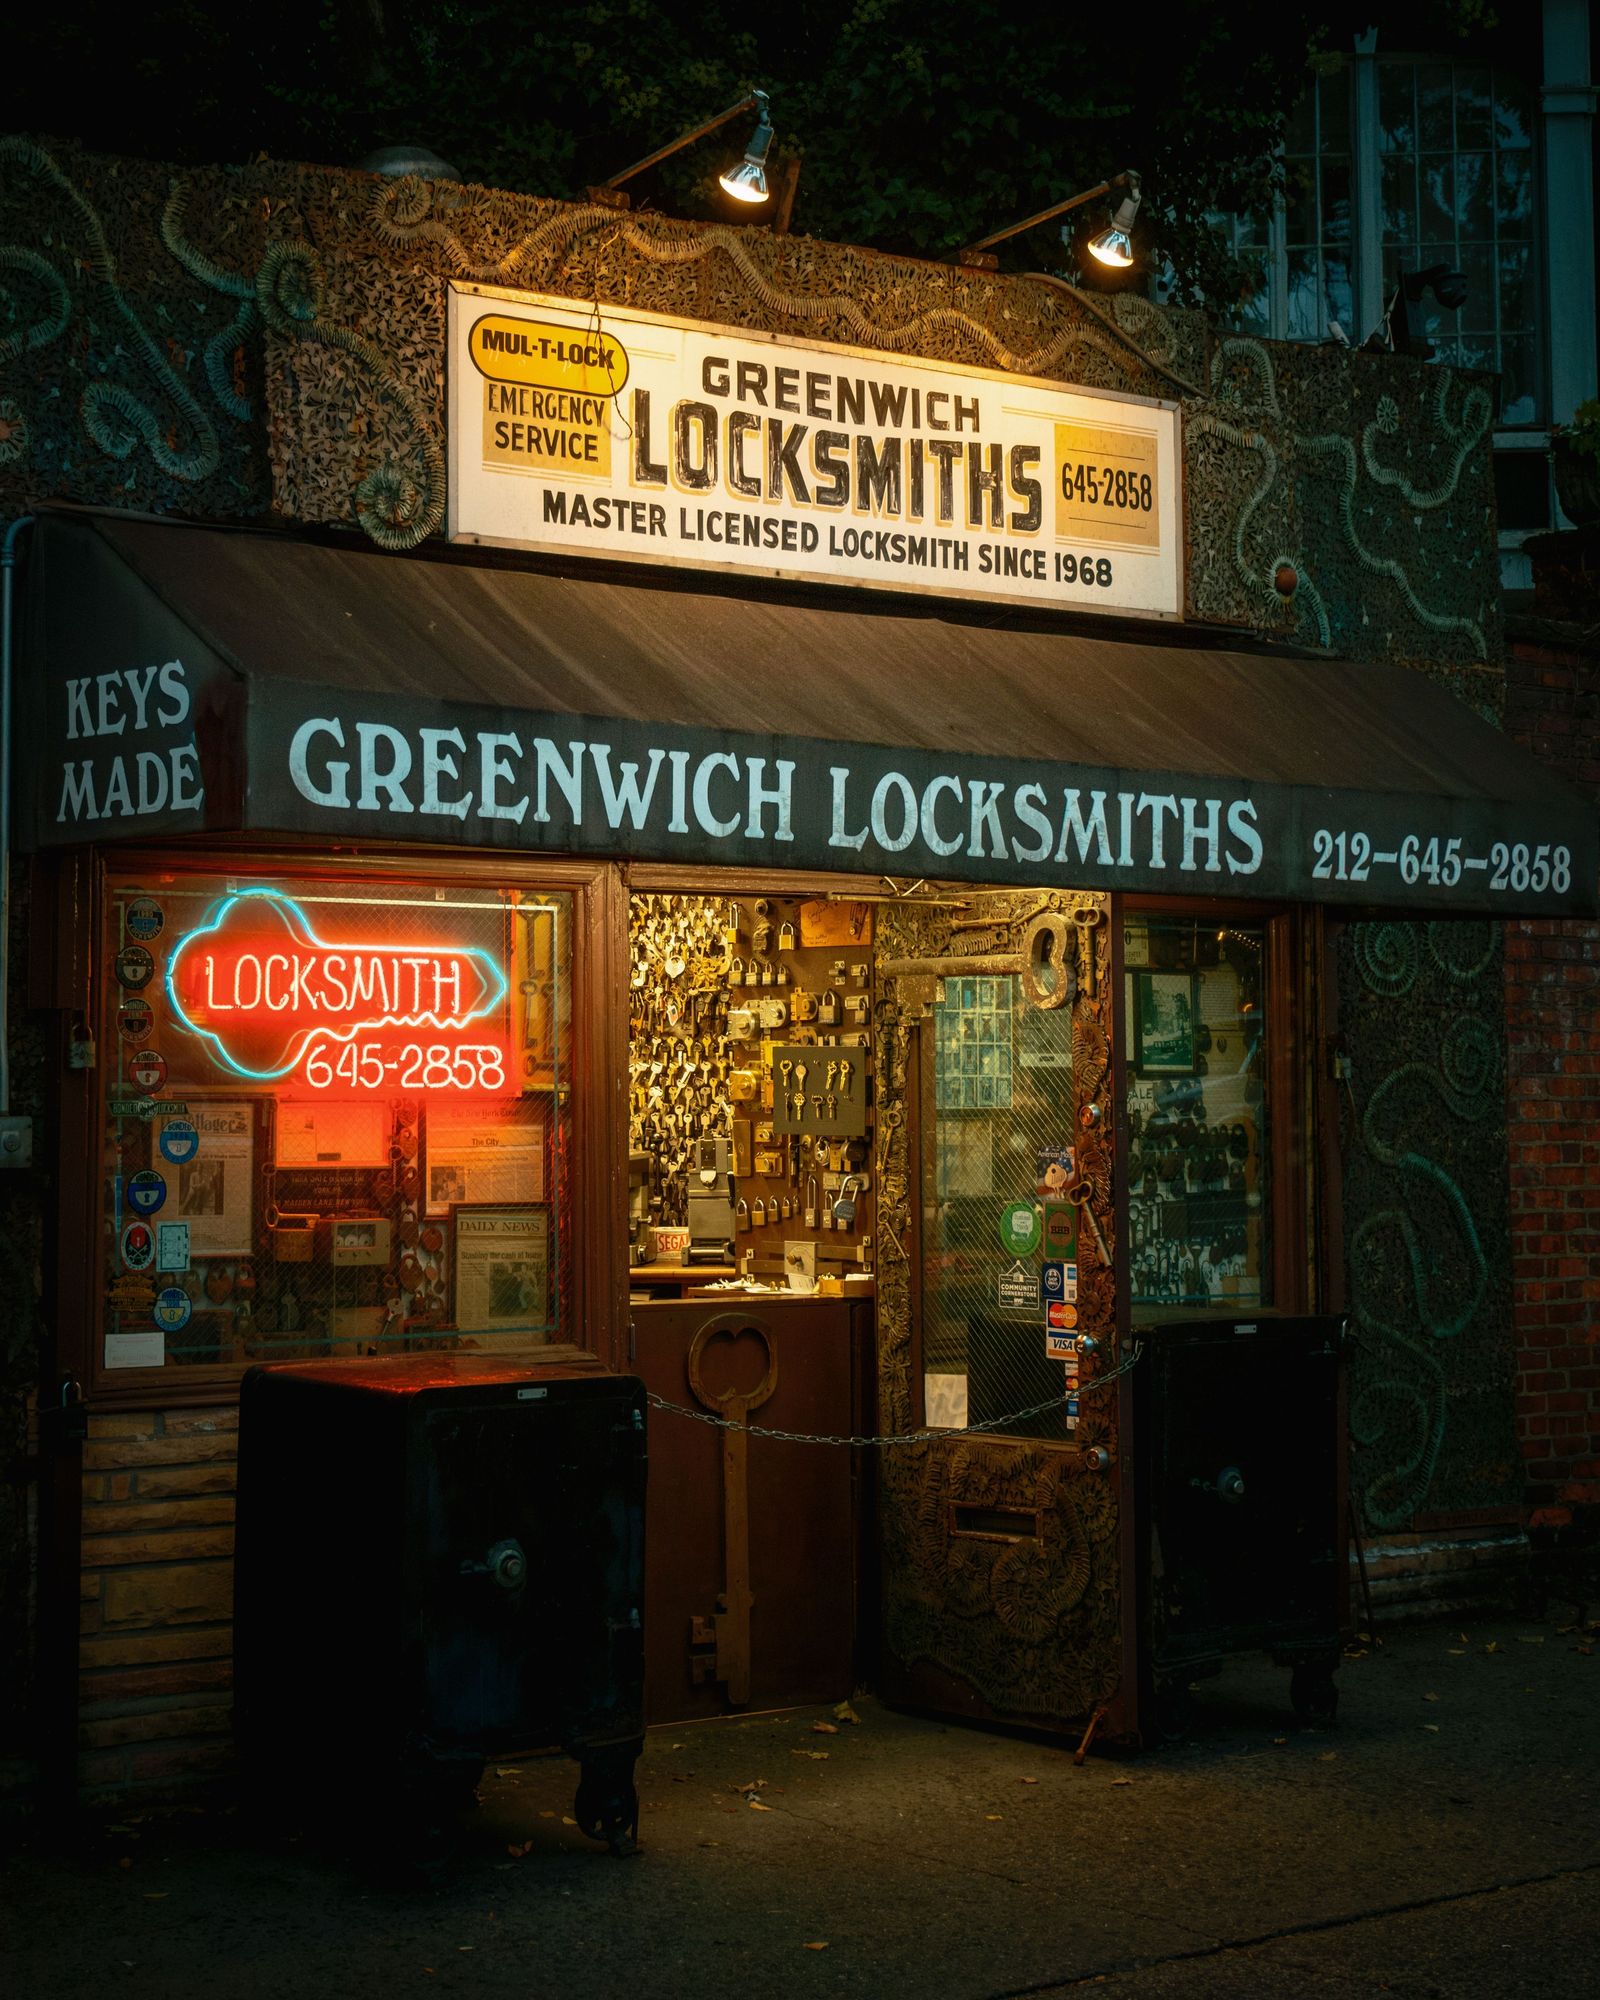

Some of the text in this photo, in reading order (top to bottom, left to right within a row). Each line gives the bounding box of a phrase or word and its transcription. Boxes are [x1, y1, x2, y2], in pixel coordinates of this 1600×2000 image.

[481, 327, 615, 370] MUL-T-LOCK
[487, 384, 605, 426] EMERGENCY
[701, 355, 981, 434] GREENWICH
[494, 420, 599, 463] SERVICE
[634, 387, 1042, 534] LOCKSMITHS
[1061, 461, 1153, 513] 645-2858
[543, 490, 1113, 588] MASTER LICENSED LOCKSMITH SINCE 1968
[65, 659, 190, 741] KEYS
[56, 743, 205, 823] MADE
[288, 715, 1264, 876] GREENWICH LOCKSMITHS
[1312, 828, 1572, 895] 212-645-2858
[205, 954, 462, 1015] LOCKSMITH
[306, 1043, 504, 1091] 645-2858
[112, 1103, 186, 1114] BONDED LOCKSMITH
[471, 1137, 500, 1147] The City
[459, 1220, 540, 1232] DAILY NEWS
[1000, 1283, 1037, 1291] COMMUNITY
[1000, 1290, 1037, 1298] CORNERSTONE
[1052, 1338, 1074, 1351] VISA
